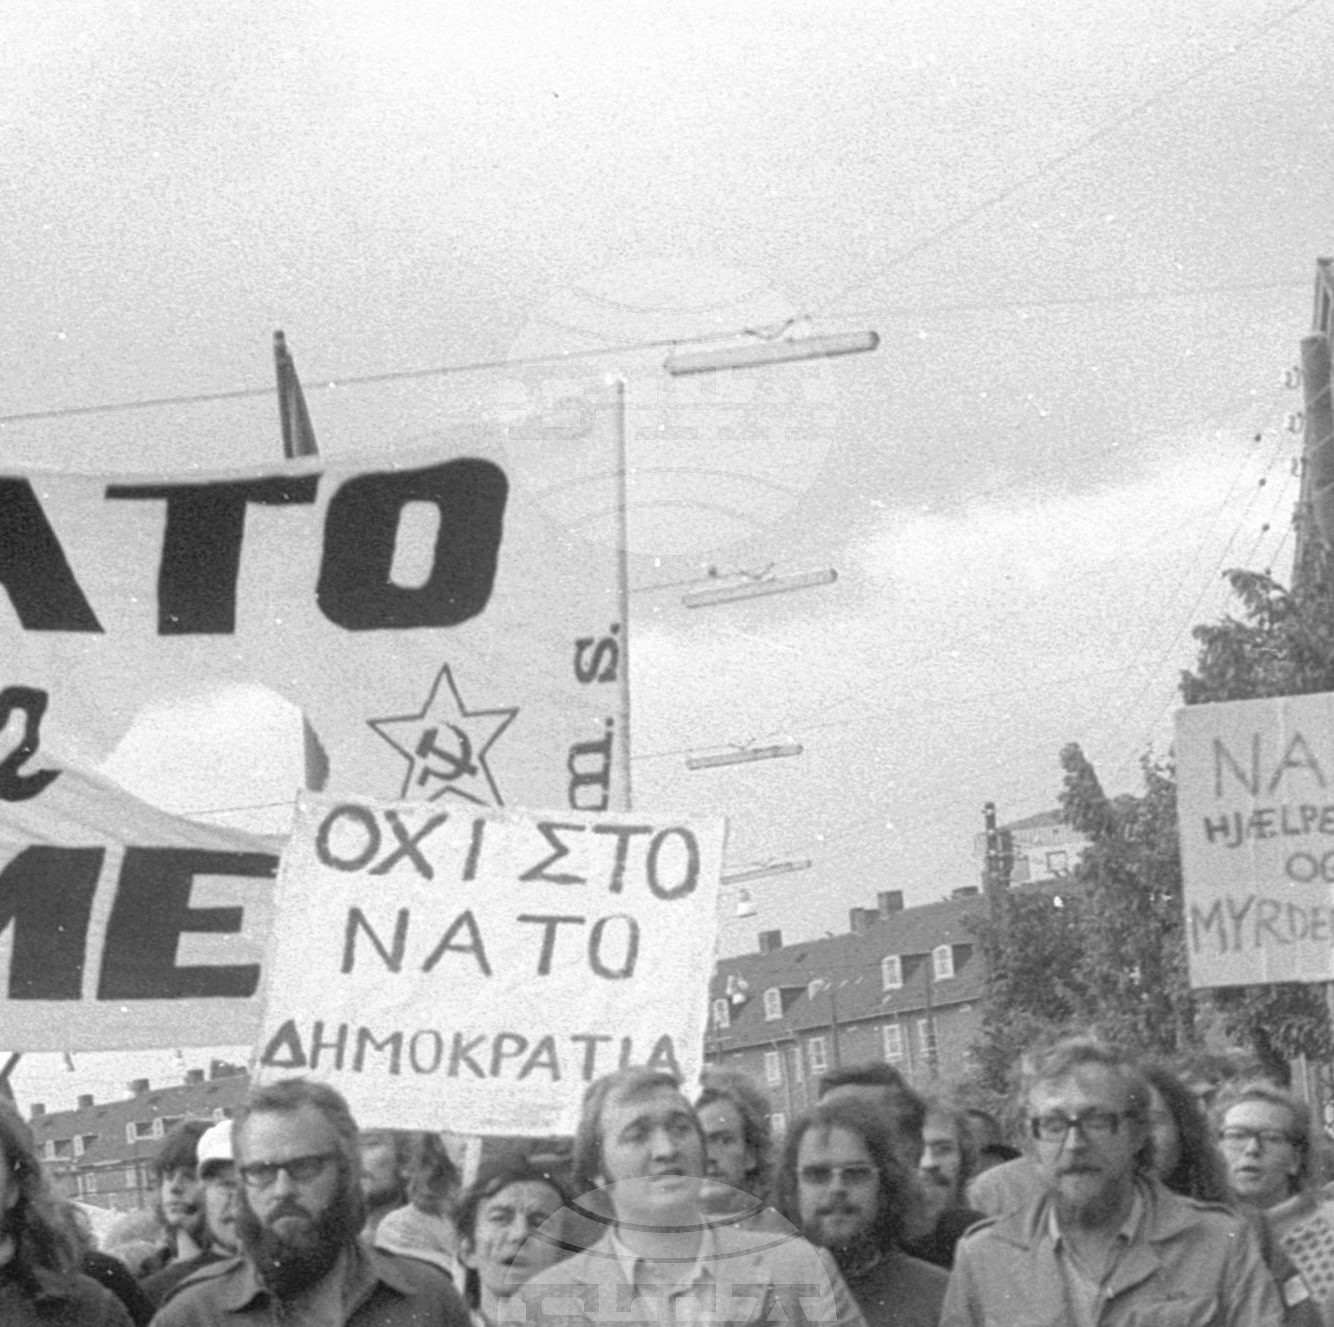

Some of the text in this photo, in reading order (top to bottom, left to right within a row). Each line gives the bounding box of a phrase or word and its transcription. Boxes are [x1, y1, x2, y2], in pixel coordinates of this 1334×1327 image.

[315, 803, 702, 902] ΟΧΙ ΣΤΟ
[340, 906, 642, 981] ΝΑΤΟ
[260, 1018, 683, 1084] ΔΗΜΟΚΡΑΤΙΑ
